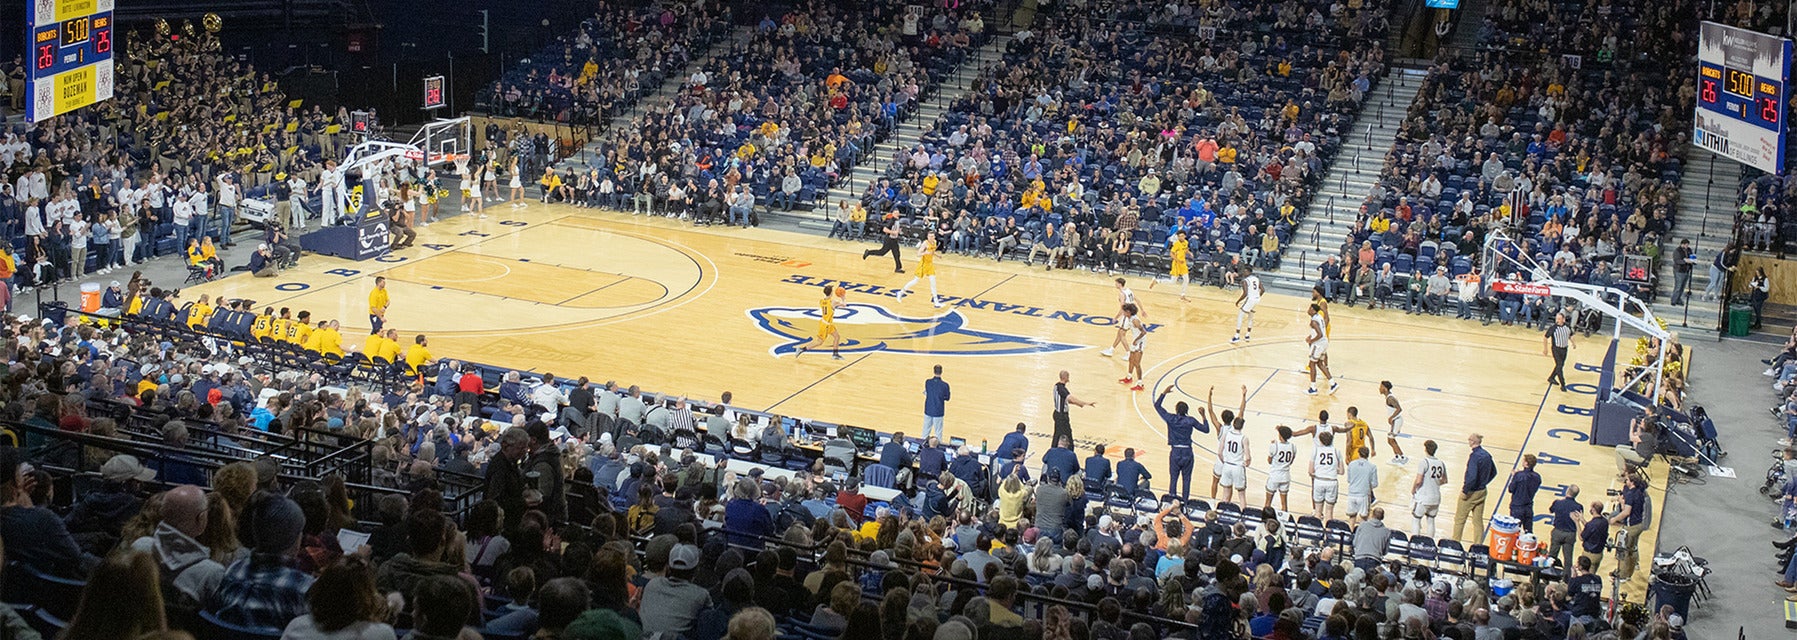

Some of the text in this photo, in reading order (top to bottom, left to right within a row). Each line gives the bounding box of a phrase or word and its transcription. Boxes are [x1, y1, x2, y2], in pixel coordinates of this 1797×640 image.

[67, 18, 88, 43] 5:00
[97, 30, 110, 53] 25
[38, 45, 52, 69] 26
[63, 81, 87, 99] BOZEMAN
[1731, 70, 1754, 97] 5:00
[1702, 80, 1716, 103] 26
[1762, 98, 1778, 123] 25
[1702, 130, 1729, 155] LITHIA
[1736, 149, 1758, 165] BILLINGS
[781, 274, 914, 298] STATE
[1252, 281, 1258, 290] 5
[256, 320, 266, 330] 15
[275, 324, 280, 335] 2
[290, 327, 298, 337] 21
[1359, 427, 1364, 440] 0
[1227, 441, 1239, 454] 10
[1278, 451, 1292, 463] 20
[1319, 453, 1334, 466] 25
[1431, 466, 1443, 479] 23
[1498, 537, 1506, 546] G
